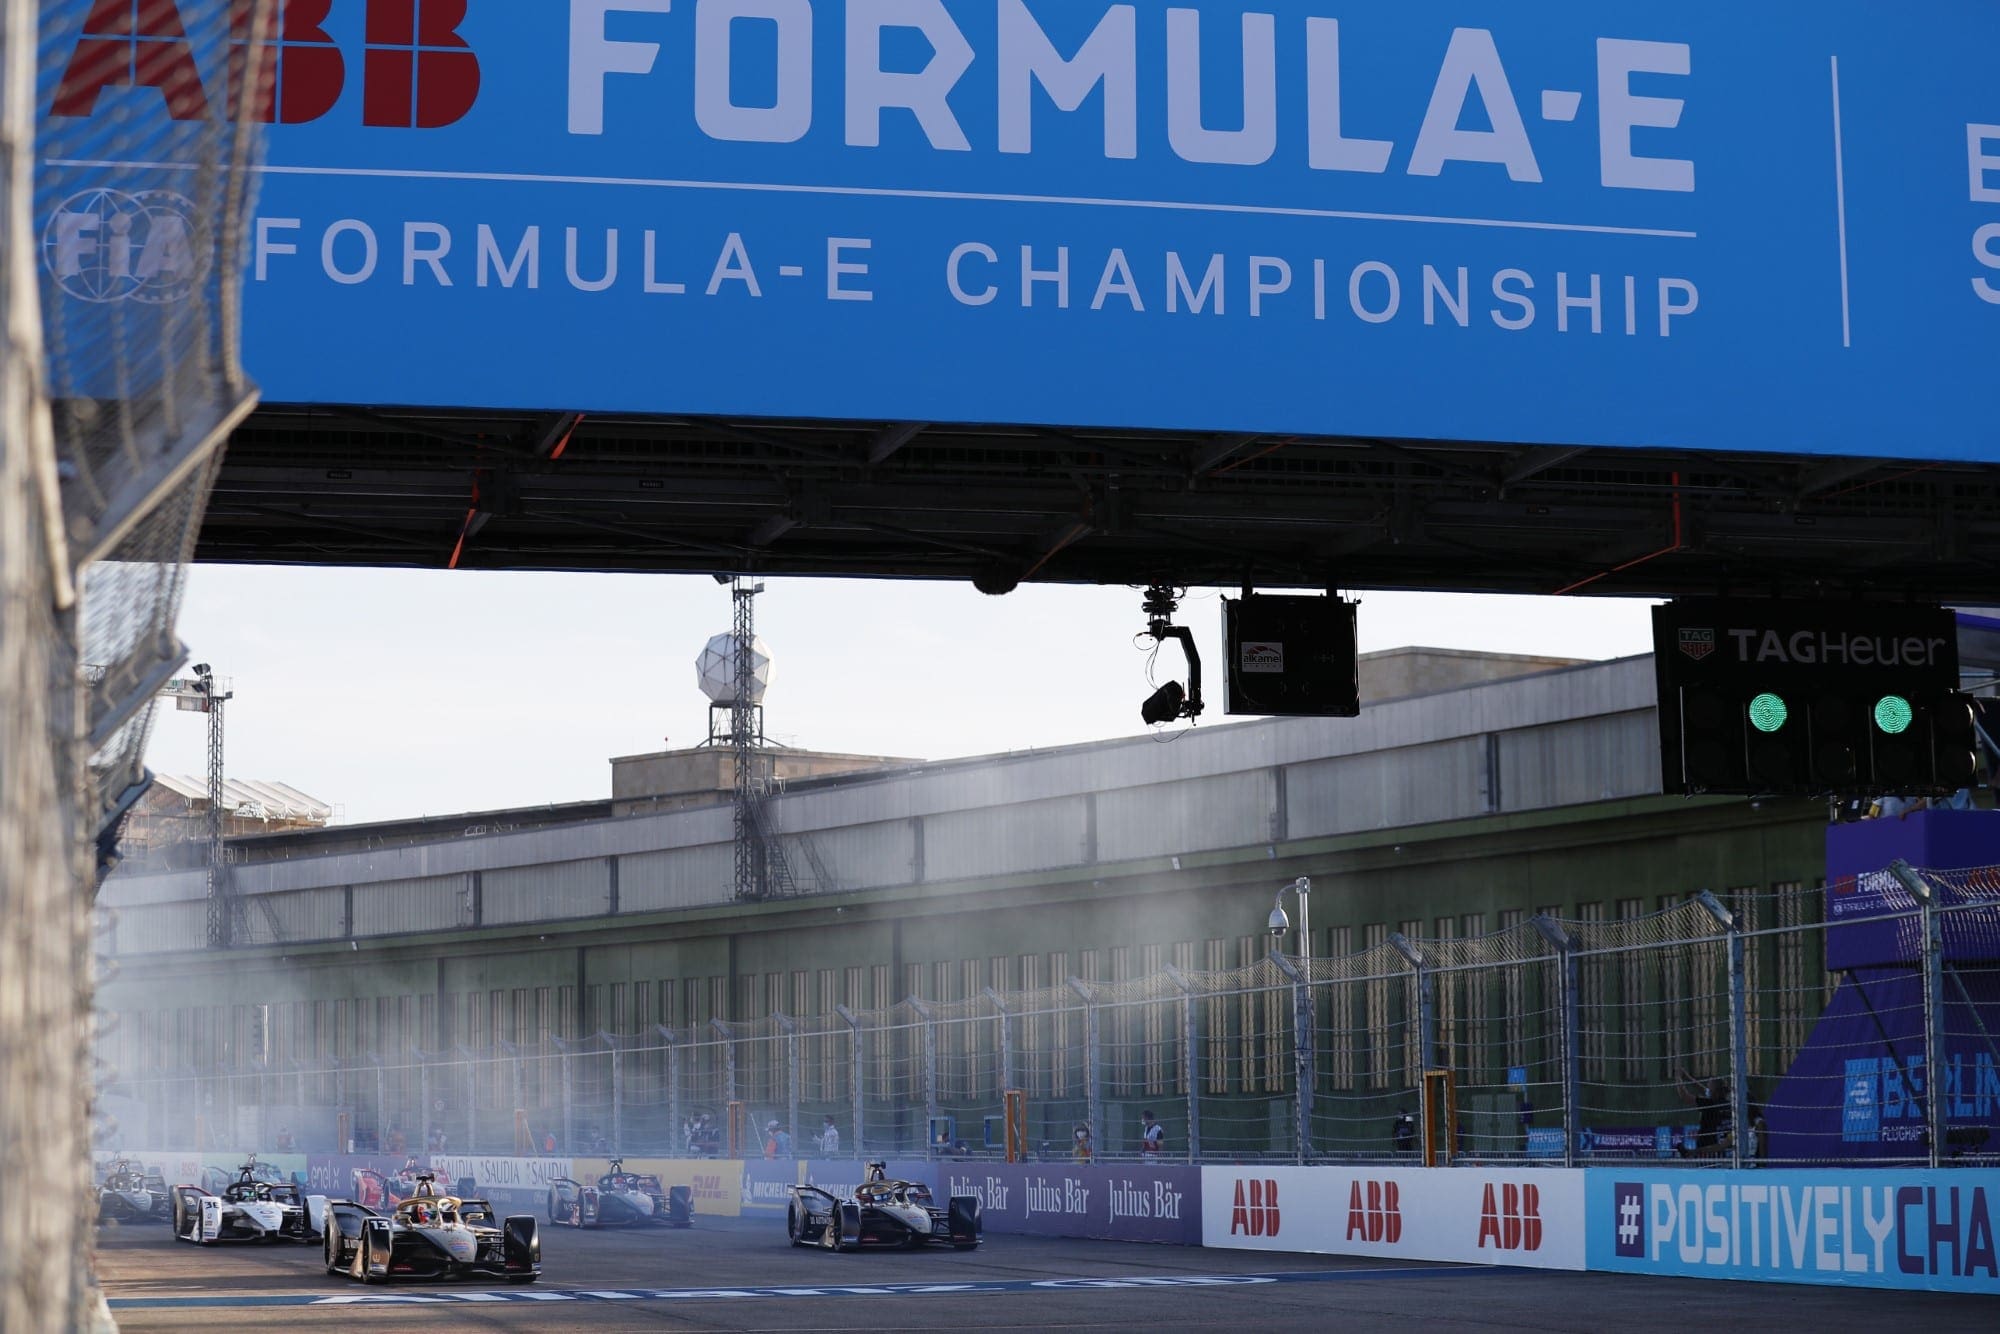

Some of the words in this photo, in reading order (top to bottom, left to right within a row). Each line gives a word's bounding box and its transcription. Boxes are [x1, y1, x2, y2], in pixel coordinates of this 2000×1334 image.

[567, 0, 1695, 192] FORMULA-E
[255, 217, 874, 302] FORMULA-E
[946, 242, 1699, 337] CHAMPIONSHIP
[1682, 631, 1710, 641] TAG
[1882, 1053, 2000, 1118] BELIN
[485, 1160, 520, 1184] SAUDIA
[986, 1176, 1009, 1210] Bär
[1025, 1177, 1061, 1219] Julius
[1064, 1178, 1090, 1214] Bär
[1109, 1179, 1150, 1224] Julius
[1154, 1181, 1182, 1219] Bär
[1231, 1179, 1280, 1237] ABB
[1346, 1180, 1401, 1243] ABB
[1478, 1183, 1542, 1251] ABB
[370, 1220, 390, 1230] 13
